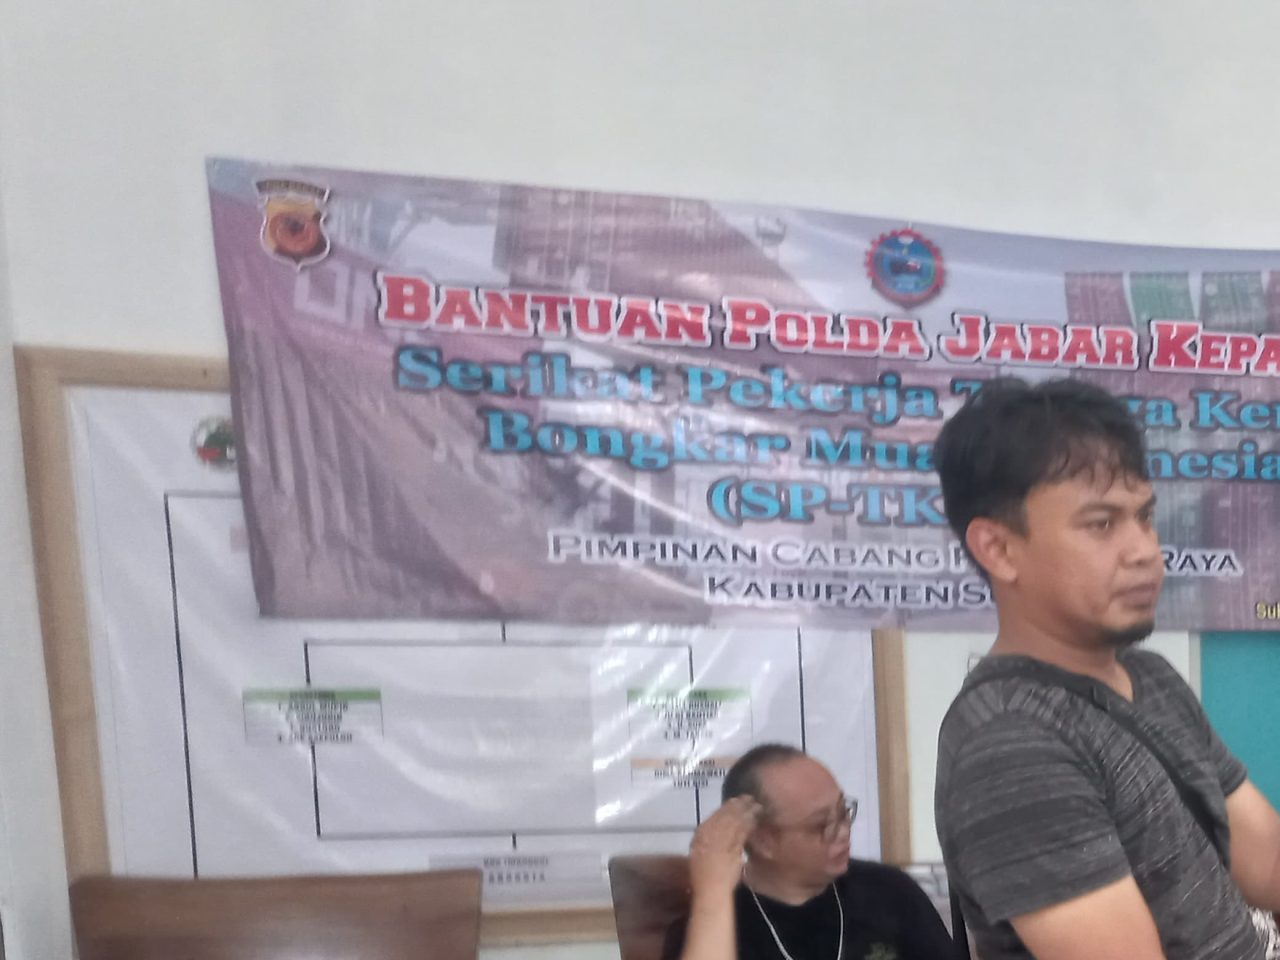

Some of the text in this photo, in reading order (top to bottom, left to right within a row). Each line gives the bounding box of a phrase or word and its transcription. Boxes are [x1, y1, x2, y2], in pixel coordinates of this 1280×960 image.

[377, 271, 712, 346] BANTUAN
[722, 297, 933, 361] POLDA
[938, 312, 1139, 371] JABAR
[396, 347, 658, 403] Serikat
[684, 363, 942, 426] Pekerja
[482, 407, 790, 471] Bongkar
[551, 534, 758, 563] PIMPINAN
[772, 540, 941, 571] CABANG
[708, 576, 950, 604] KABUPATEN
